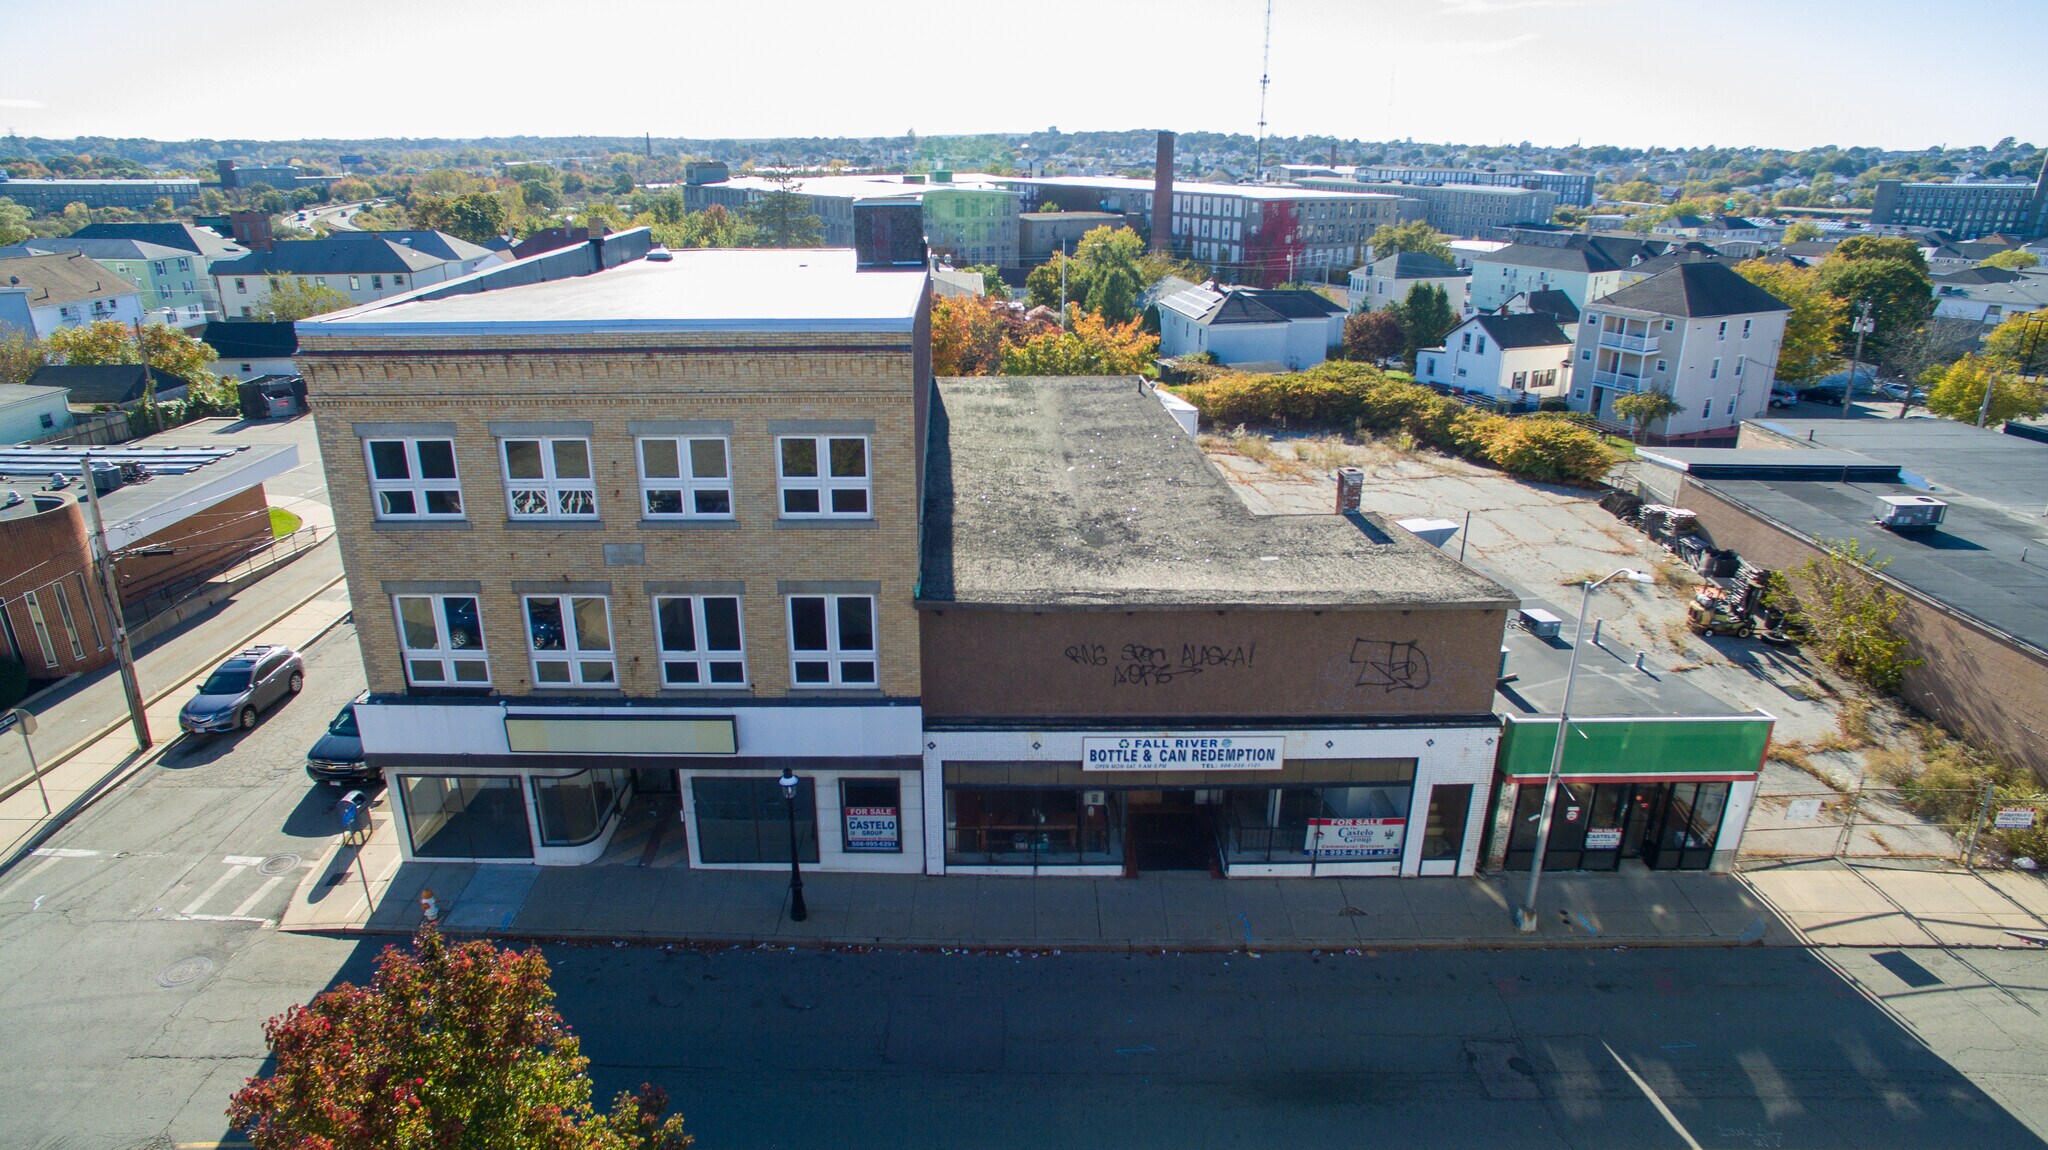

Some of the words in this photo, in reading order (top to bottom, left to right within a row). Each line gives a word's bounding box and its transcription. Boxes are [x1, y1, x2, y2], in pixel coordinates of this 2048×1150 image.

[1134, 740, 1169, 748] FALL
[1175, 740, 1218, 748] RIVER
[1089, 750, 1138, 762] BOTTLE
[1142, 750, 1152, 762] &
[1159, 749, 1187, 762] CAN
[1192, 748, 1276, 762] REDEMPTION
[849, 821, 895, 829] CASTELO
[1338, 827, 1374, 838] Castelo
